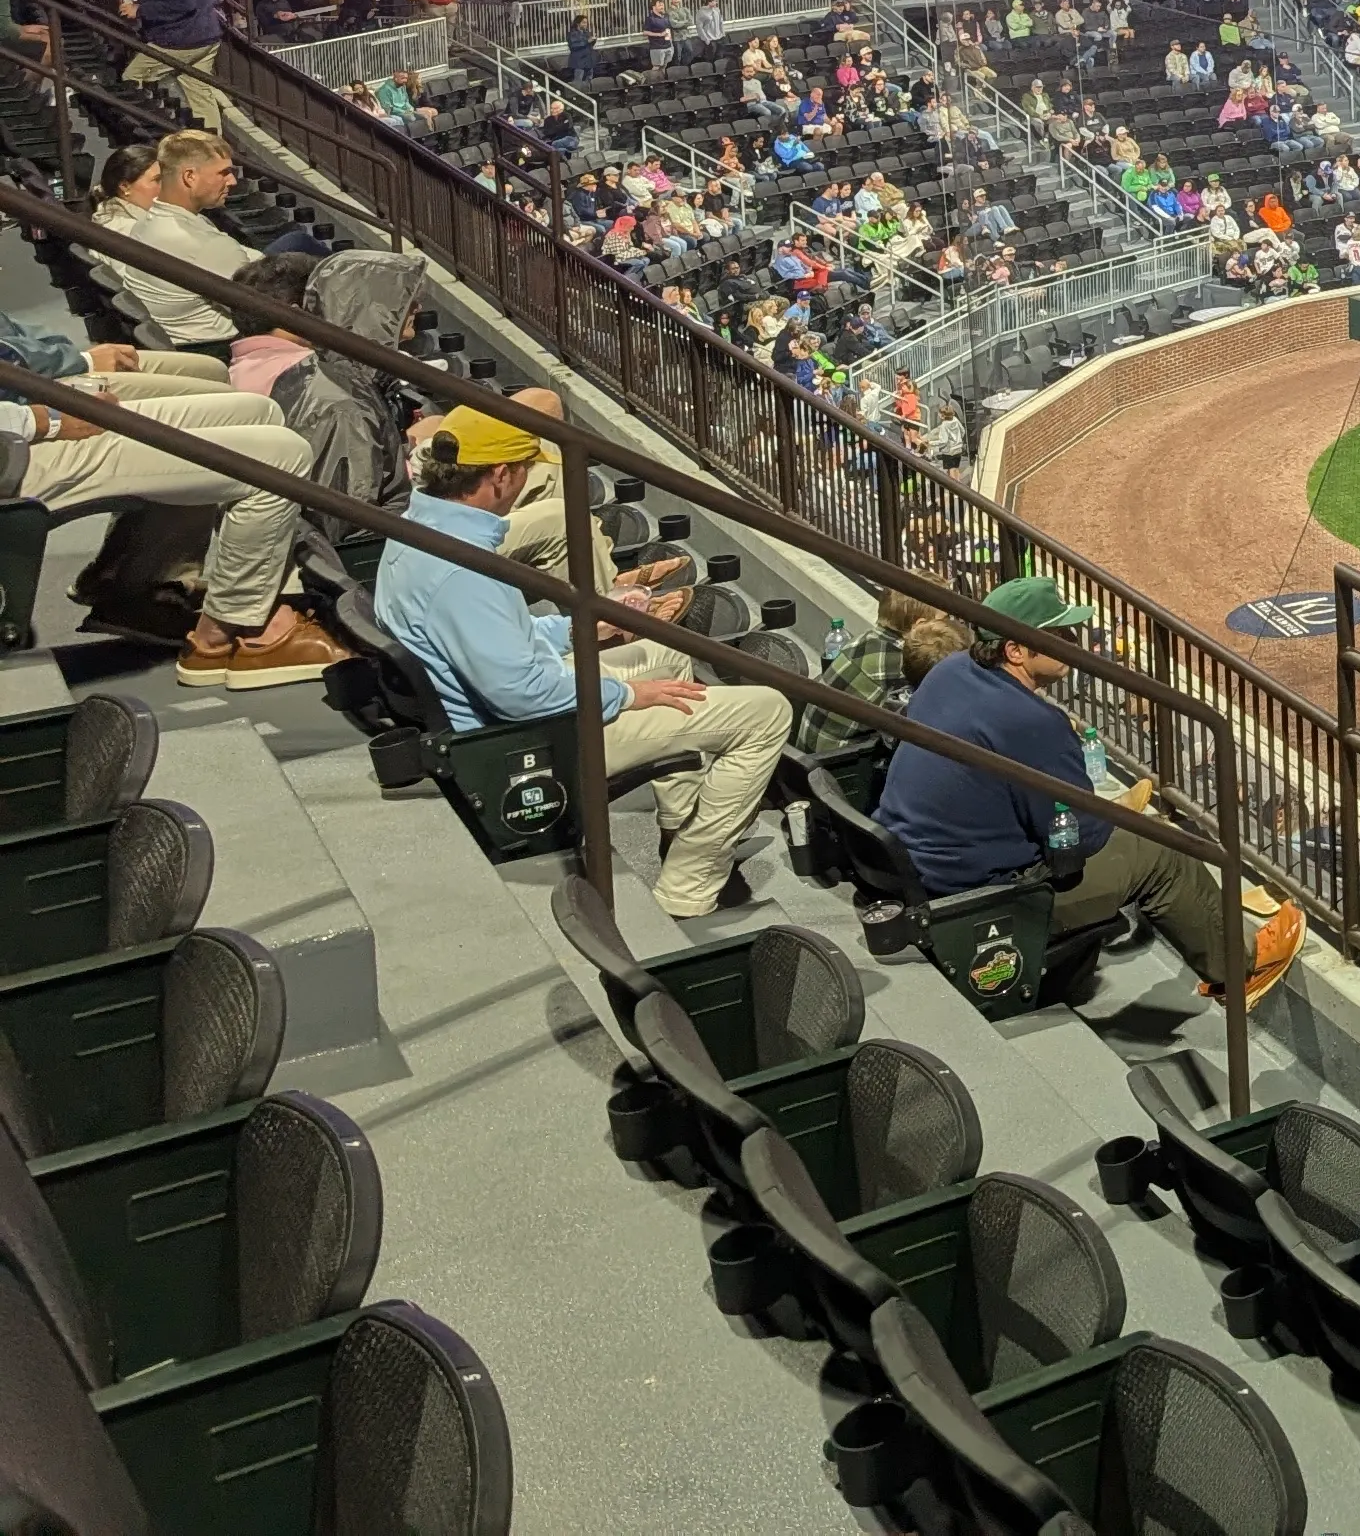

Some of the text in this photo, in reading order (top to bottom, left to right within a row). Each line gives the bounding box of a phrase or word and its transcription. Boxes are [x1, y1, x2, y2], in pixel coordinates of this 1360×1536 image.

[523, 753, 536, 769] B
[506, 800, 561, 820] FIFTH THIRD
[987, 924, 1000, 938] A
